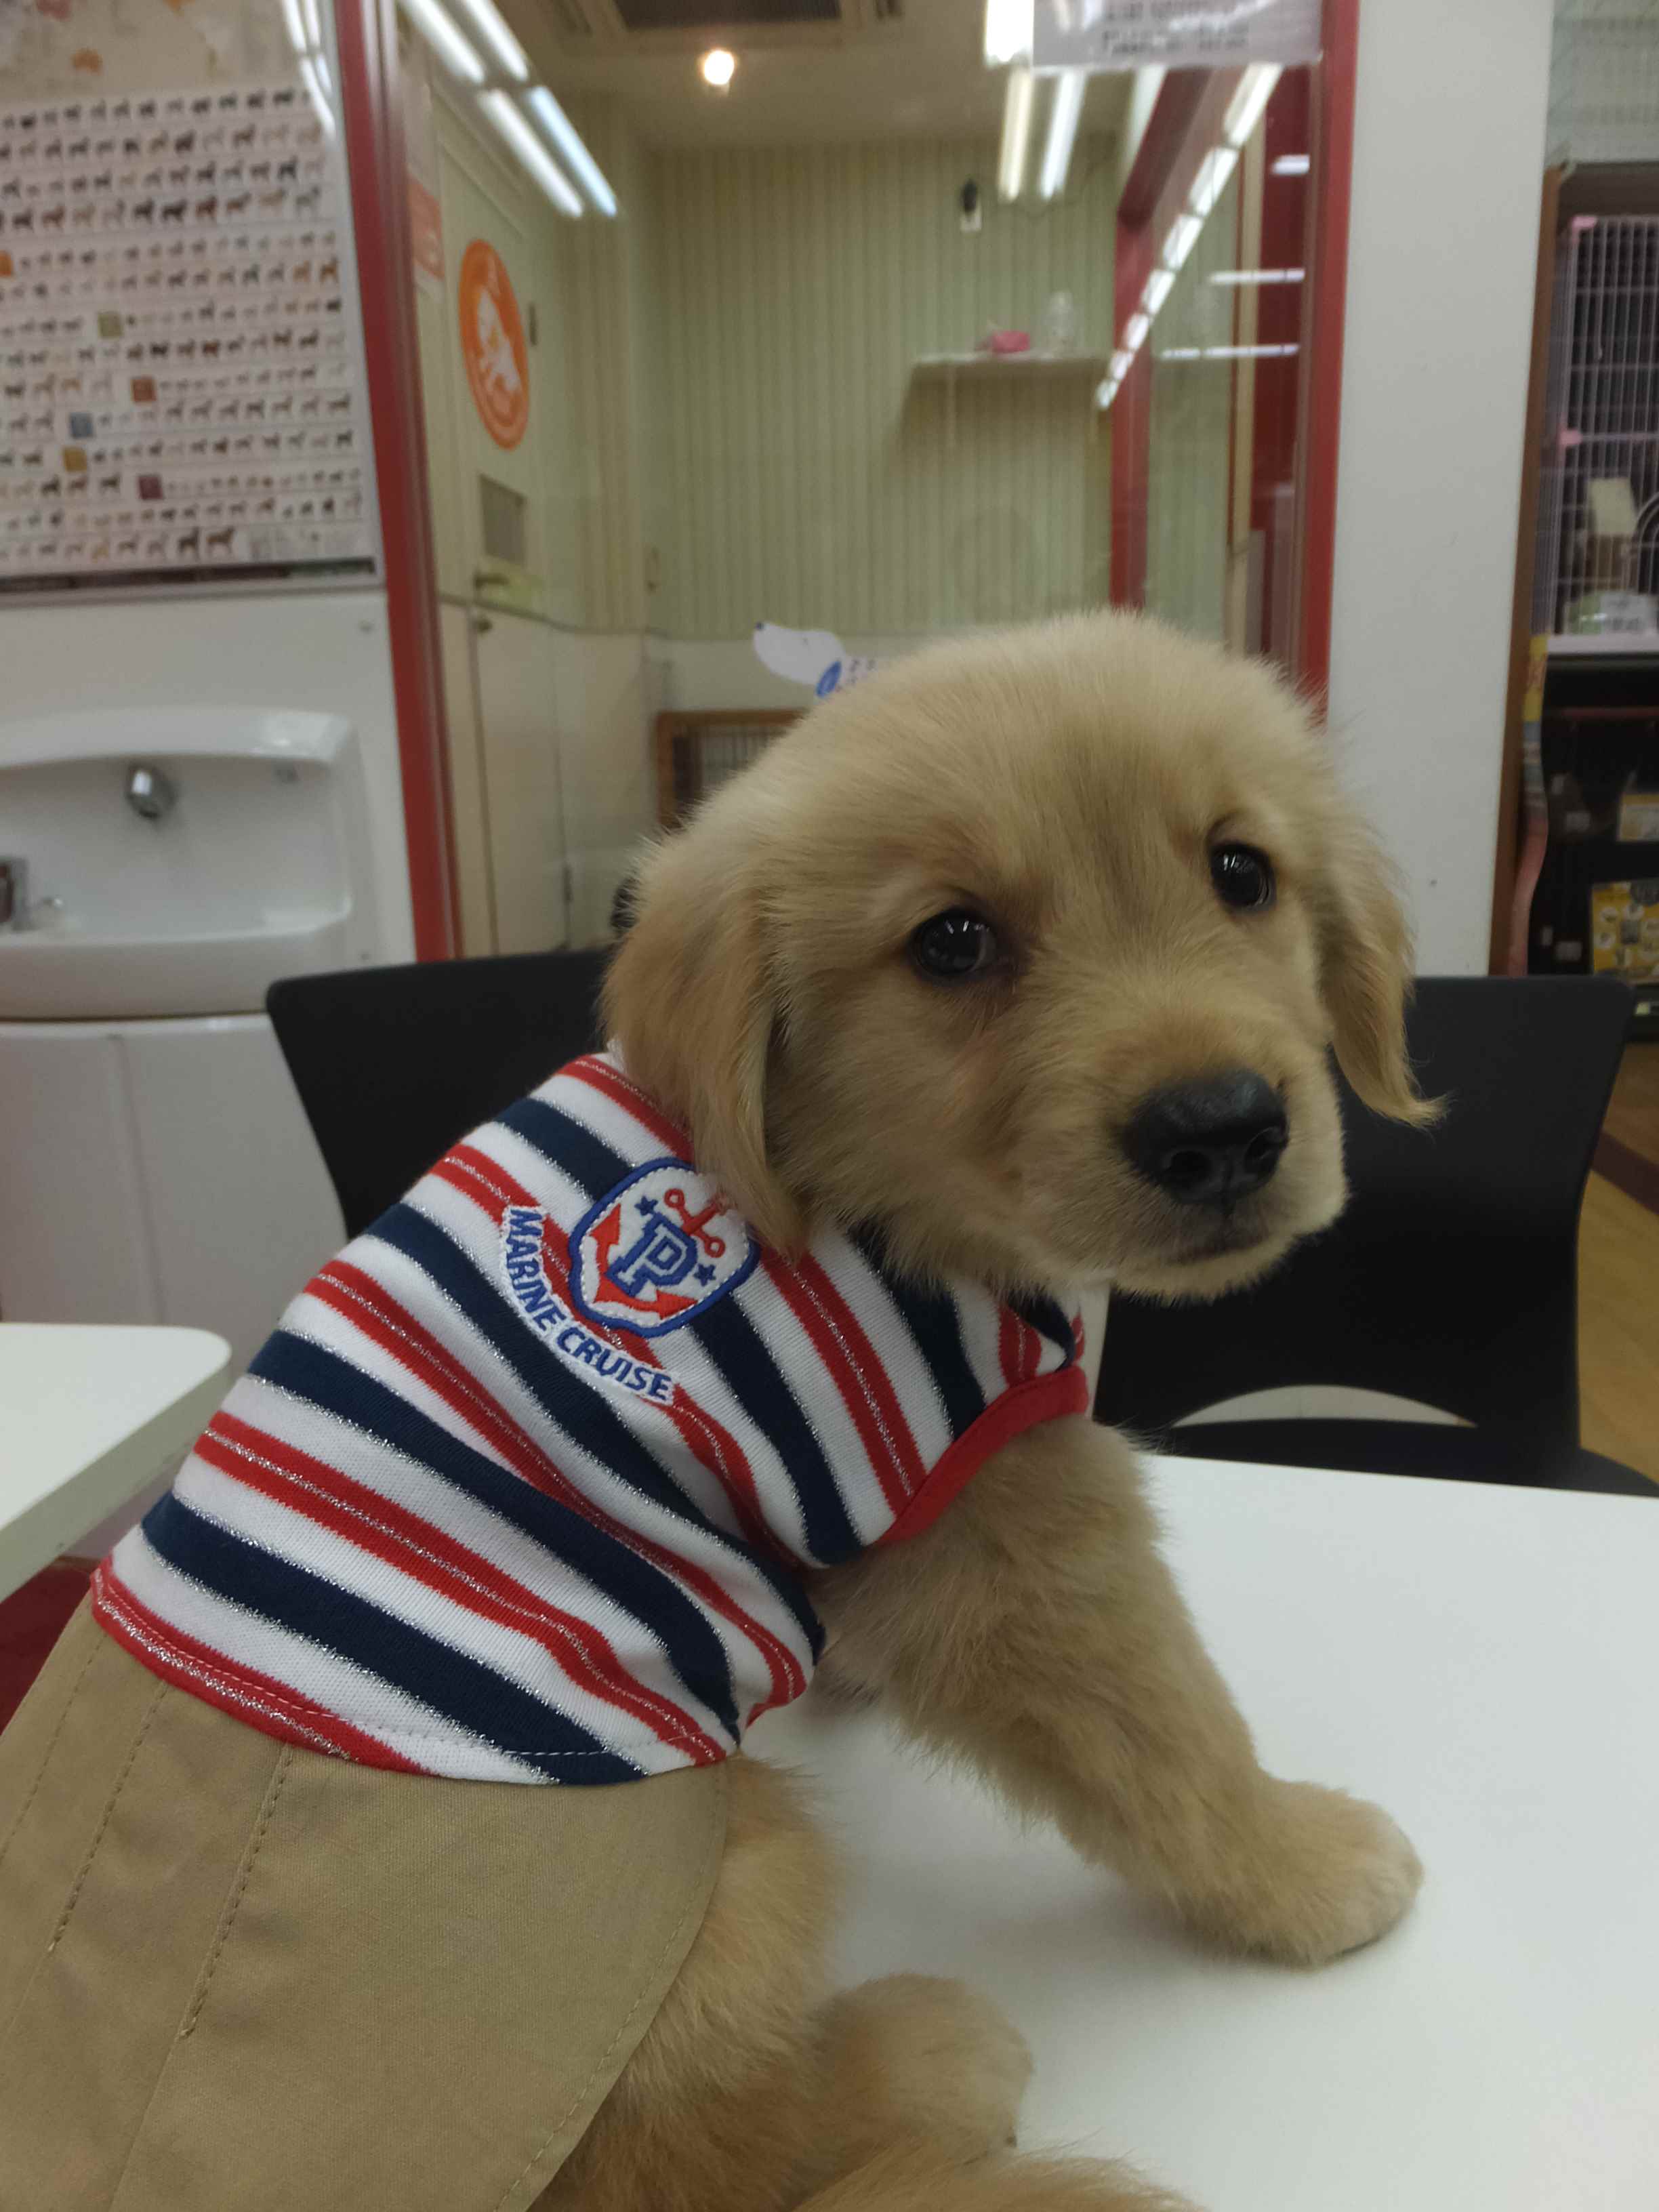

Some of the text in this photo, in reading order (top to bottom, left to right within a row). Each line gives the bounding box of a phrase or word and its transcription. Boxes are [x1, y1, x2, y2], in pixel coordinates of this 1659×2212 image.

[506, 1208, 672, 1401] MARINE CRUISE
[607, 1212, 698, 1297] P
